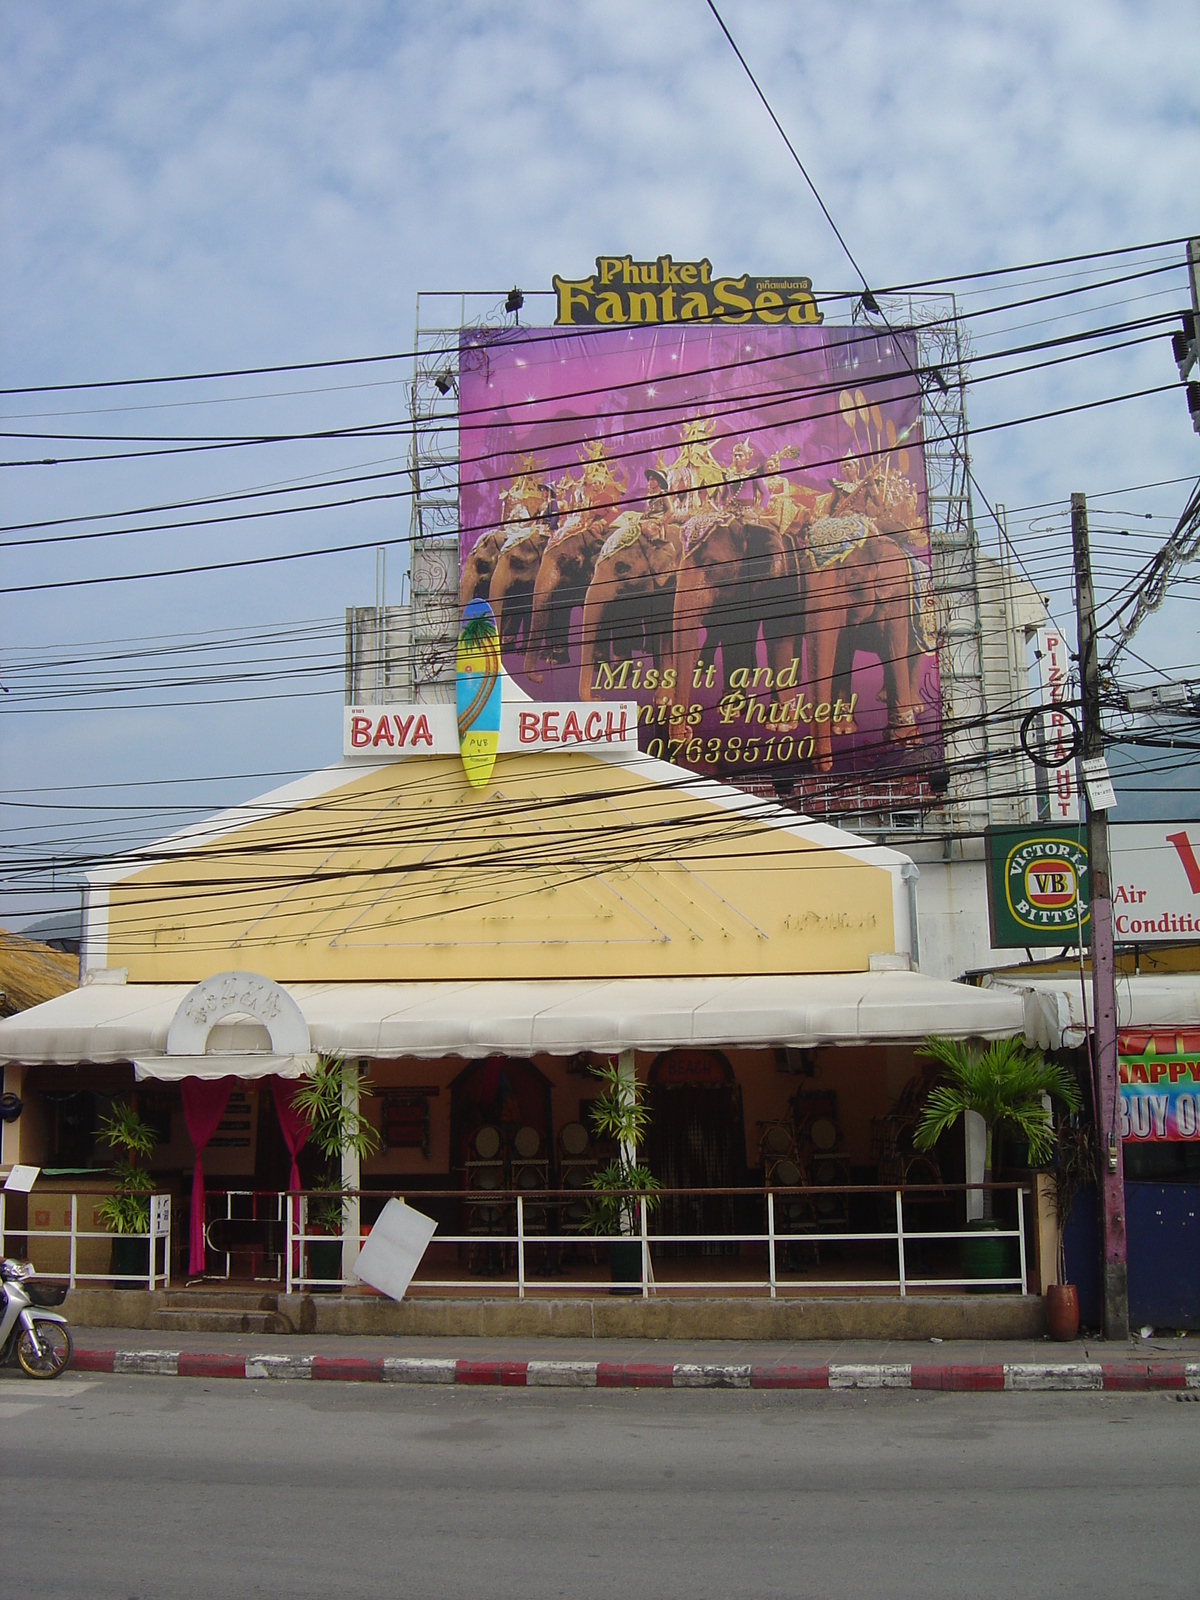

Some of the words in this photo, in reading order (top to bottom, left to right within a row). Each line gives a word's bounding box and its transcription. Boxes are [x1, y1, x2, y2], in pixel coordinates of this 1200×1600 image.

[600, 258, 711, 285] Phuket
[556, 276, 822, 324] FantaSea
[591, 661, 678, 690] Miss
[693, 660, 716, 689] it
[729, 658, 799, 690] and
[719, 690, 858, 725] Phuket!
[351, 714, 433, 748] BAYA
[469, 738, 489, 747] PUB
[519, 710, 627, 744] BEACH
[647, 735, 815, 764] 076385100
[1055, 769, 1071, 817] HUT
[1010, 843, 1088, 877] VICTORIA
[1033, 873, 1068, 894] VB
[1113, 884, 1147, 904] Air
[1015, 898, 1088, 923] BITTER
[668, 1060, 711, 1075] BEACH
[1120, 1094, 1169, 1138] BUY
[1176, 1094, 1200, 1138] O
